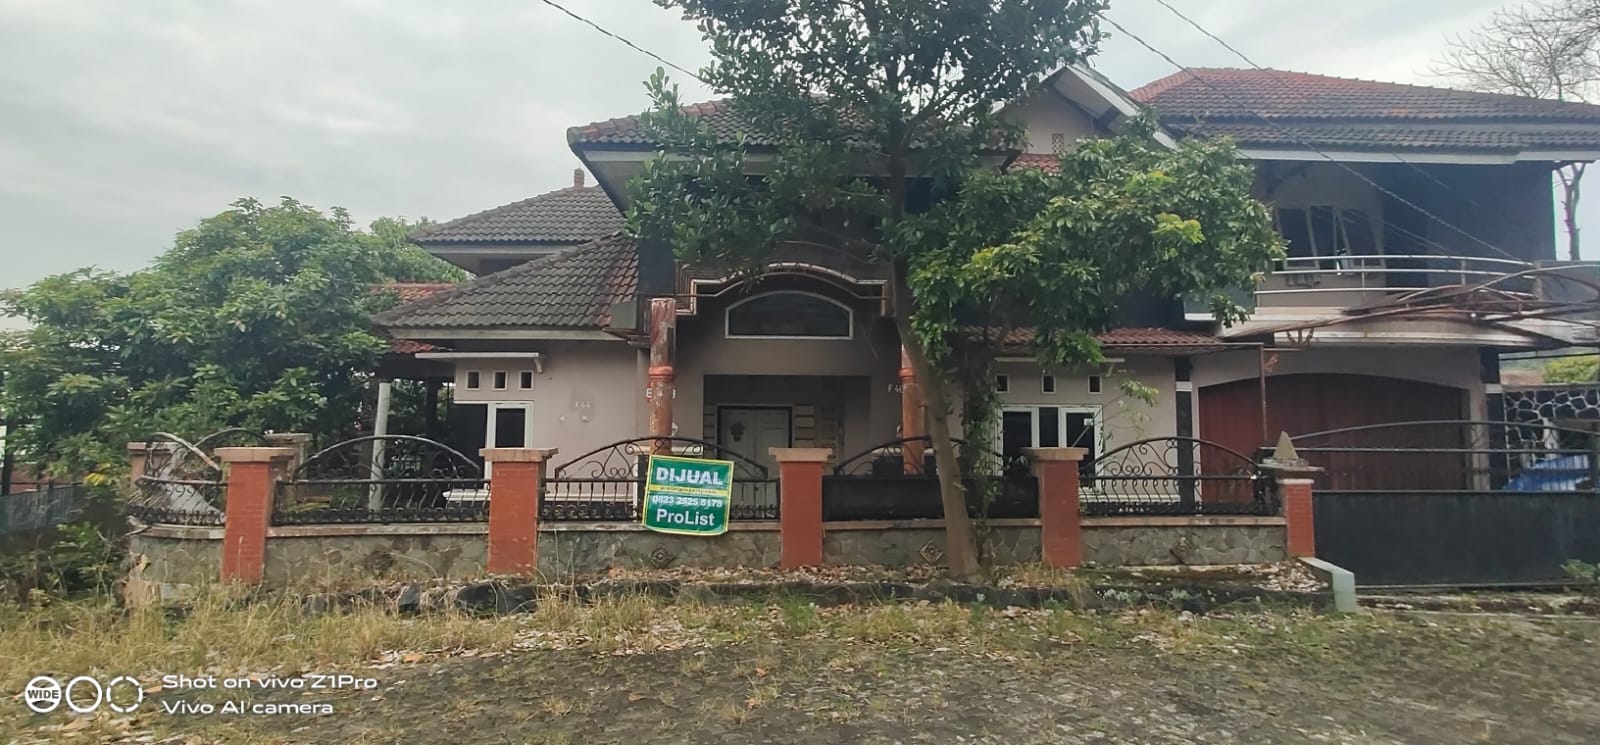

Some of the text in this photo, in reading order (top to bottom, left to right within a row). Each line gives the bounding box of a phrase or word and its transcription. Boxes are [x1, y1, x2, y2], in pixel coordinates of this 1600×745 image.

[656, 467, 724, 485] DIJUAL
[652, 495, 674, 505] 0823
[676, 496, 699, 507] 2525
[656, 508, 715, 526] ProList
